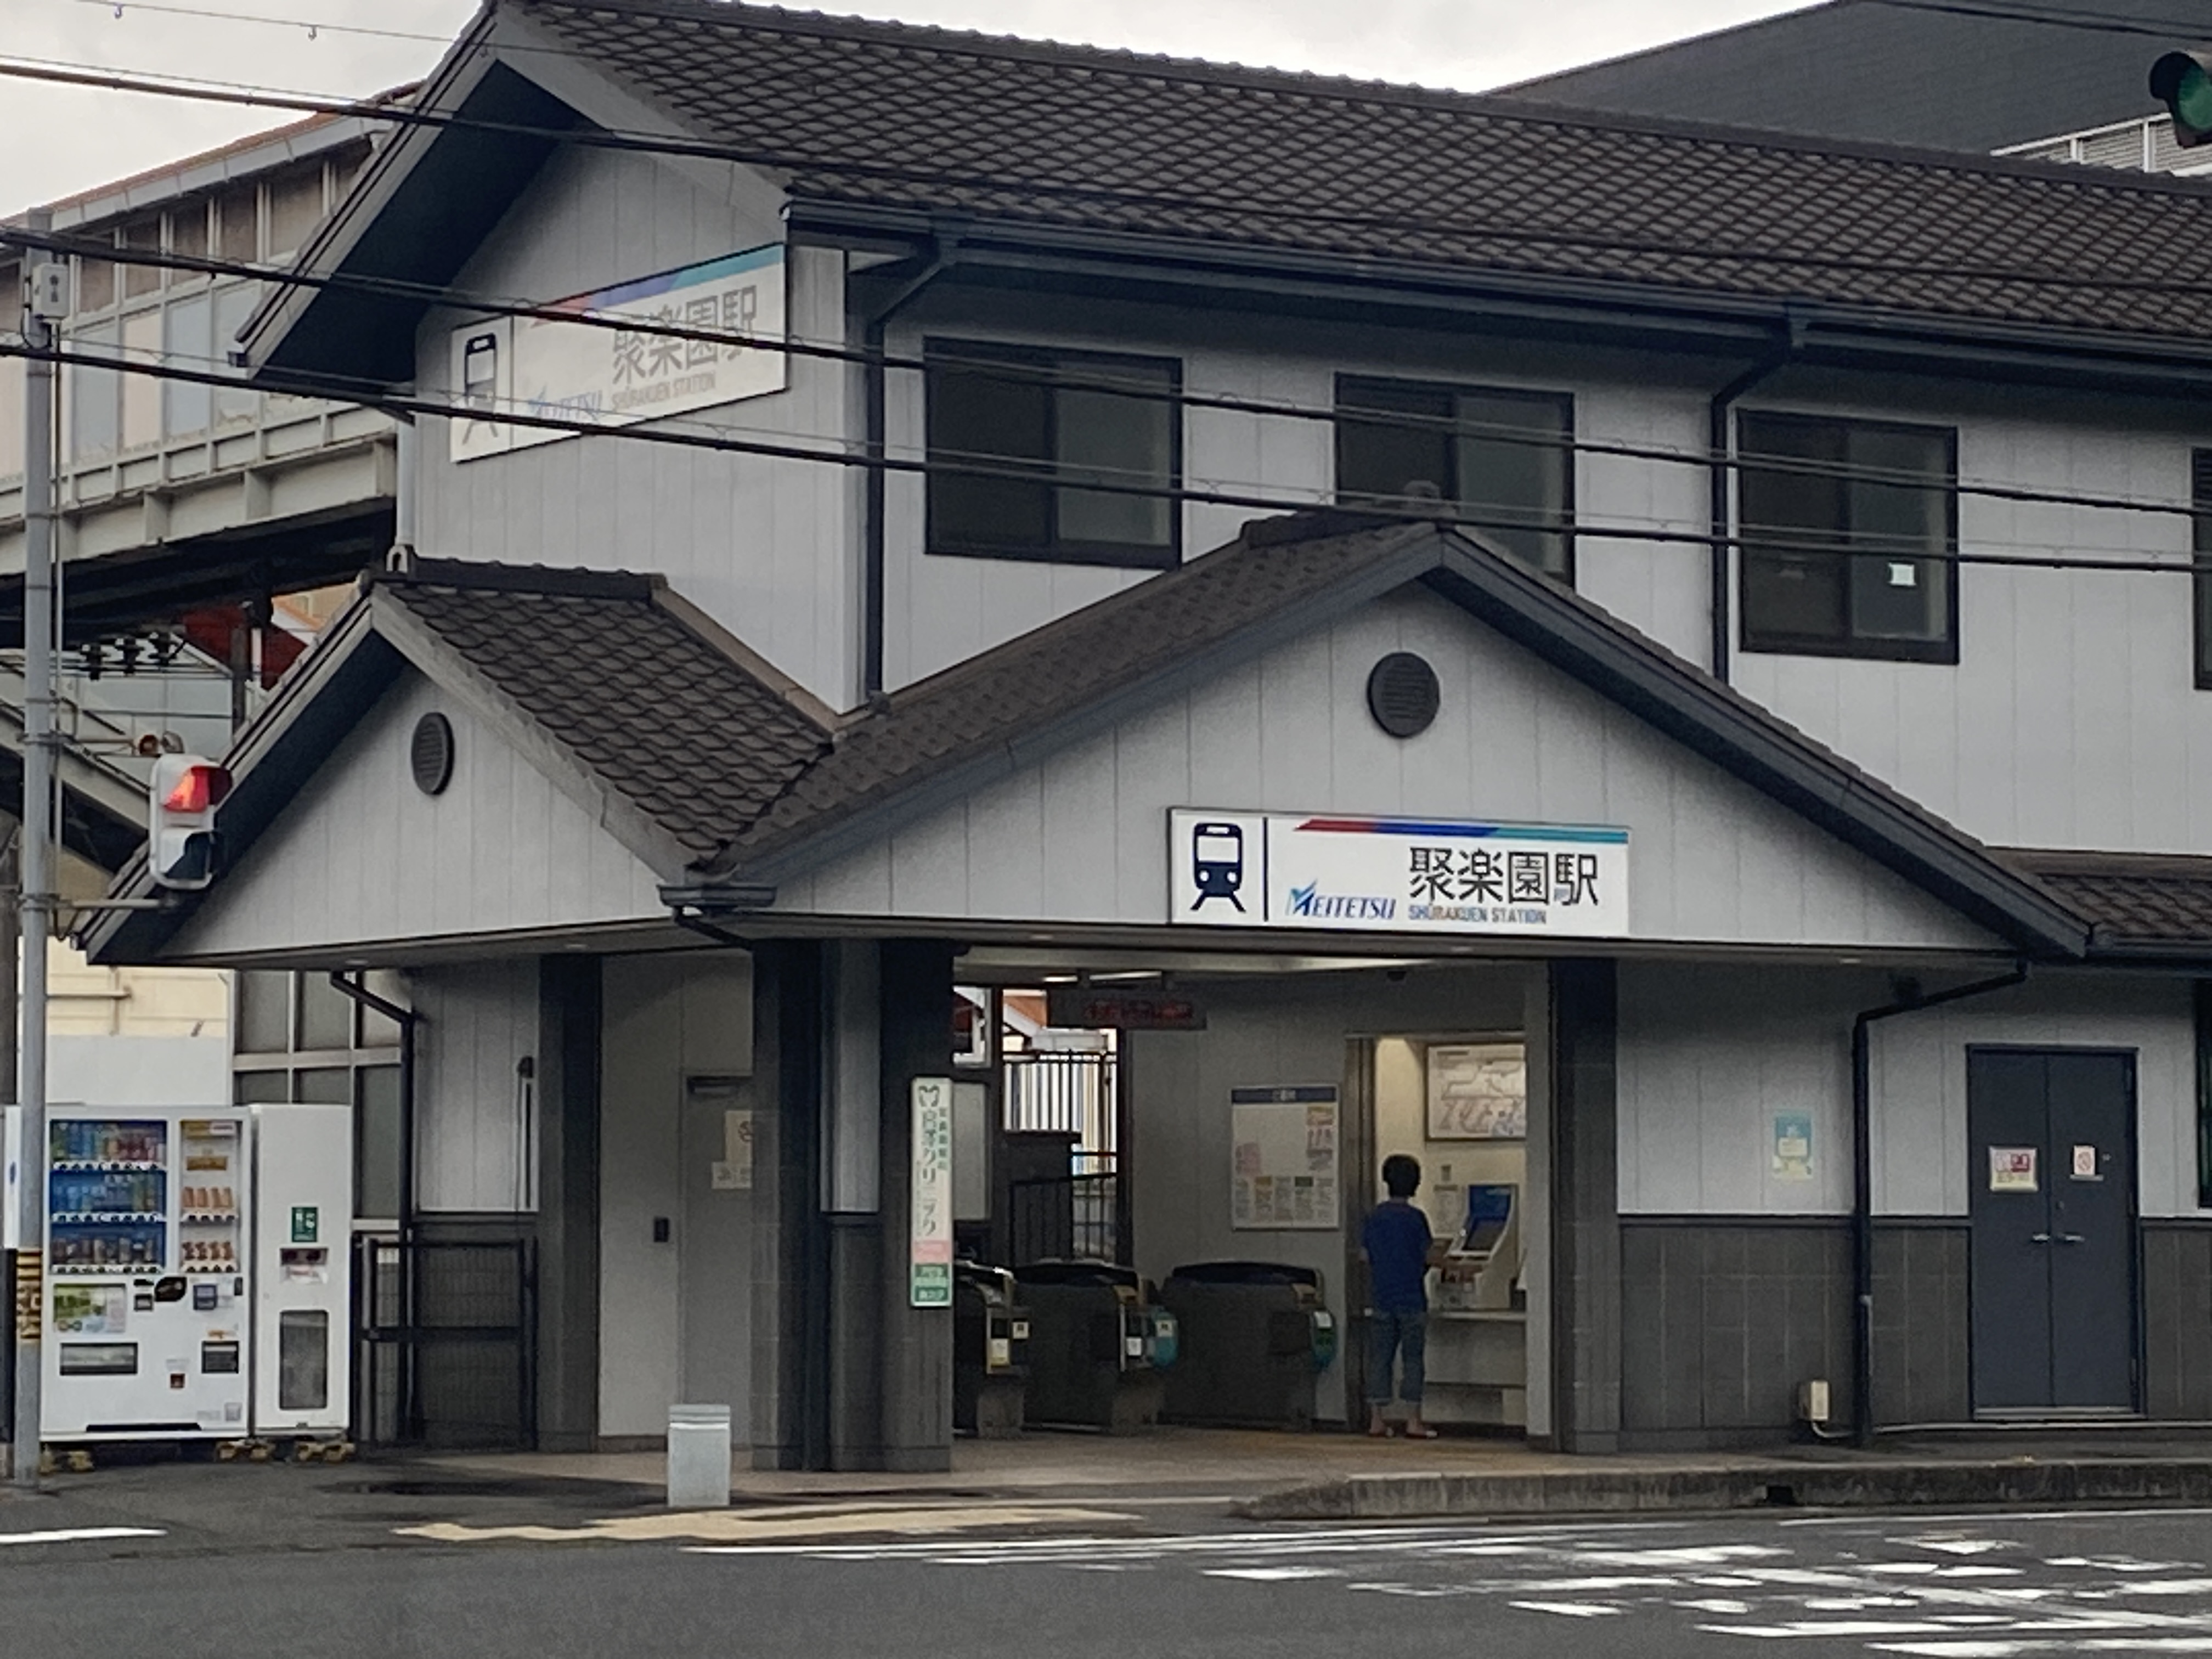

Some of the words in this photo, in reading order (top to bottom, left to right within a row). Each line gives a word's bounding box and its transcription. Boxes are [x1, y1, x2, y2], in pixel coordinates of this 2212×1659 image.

[612, 284, 758, 384] 聚楽園駅
[1285, 878, 1397, 919] MEITETSU
[1409, 848, 1599, 906] 聚楽園駅
[1492, 907, 1547, 924] STATION
